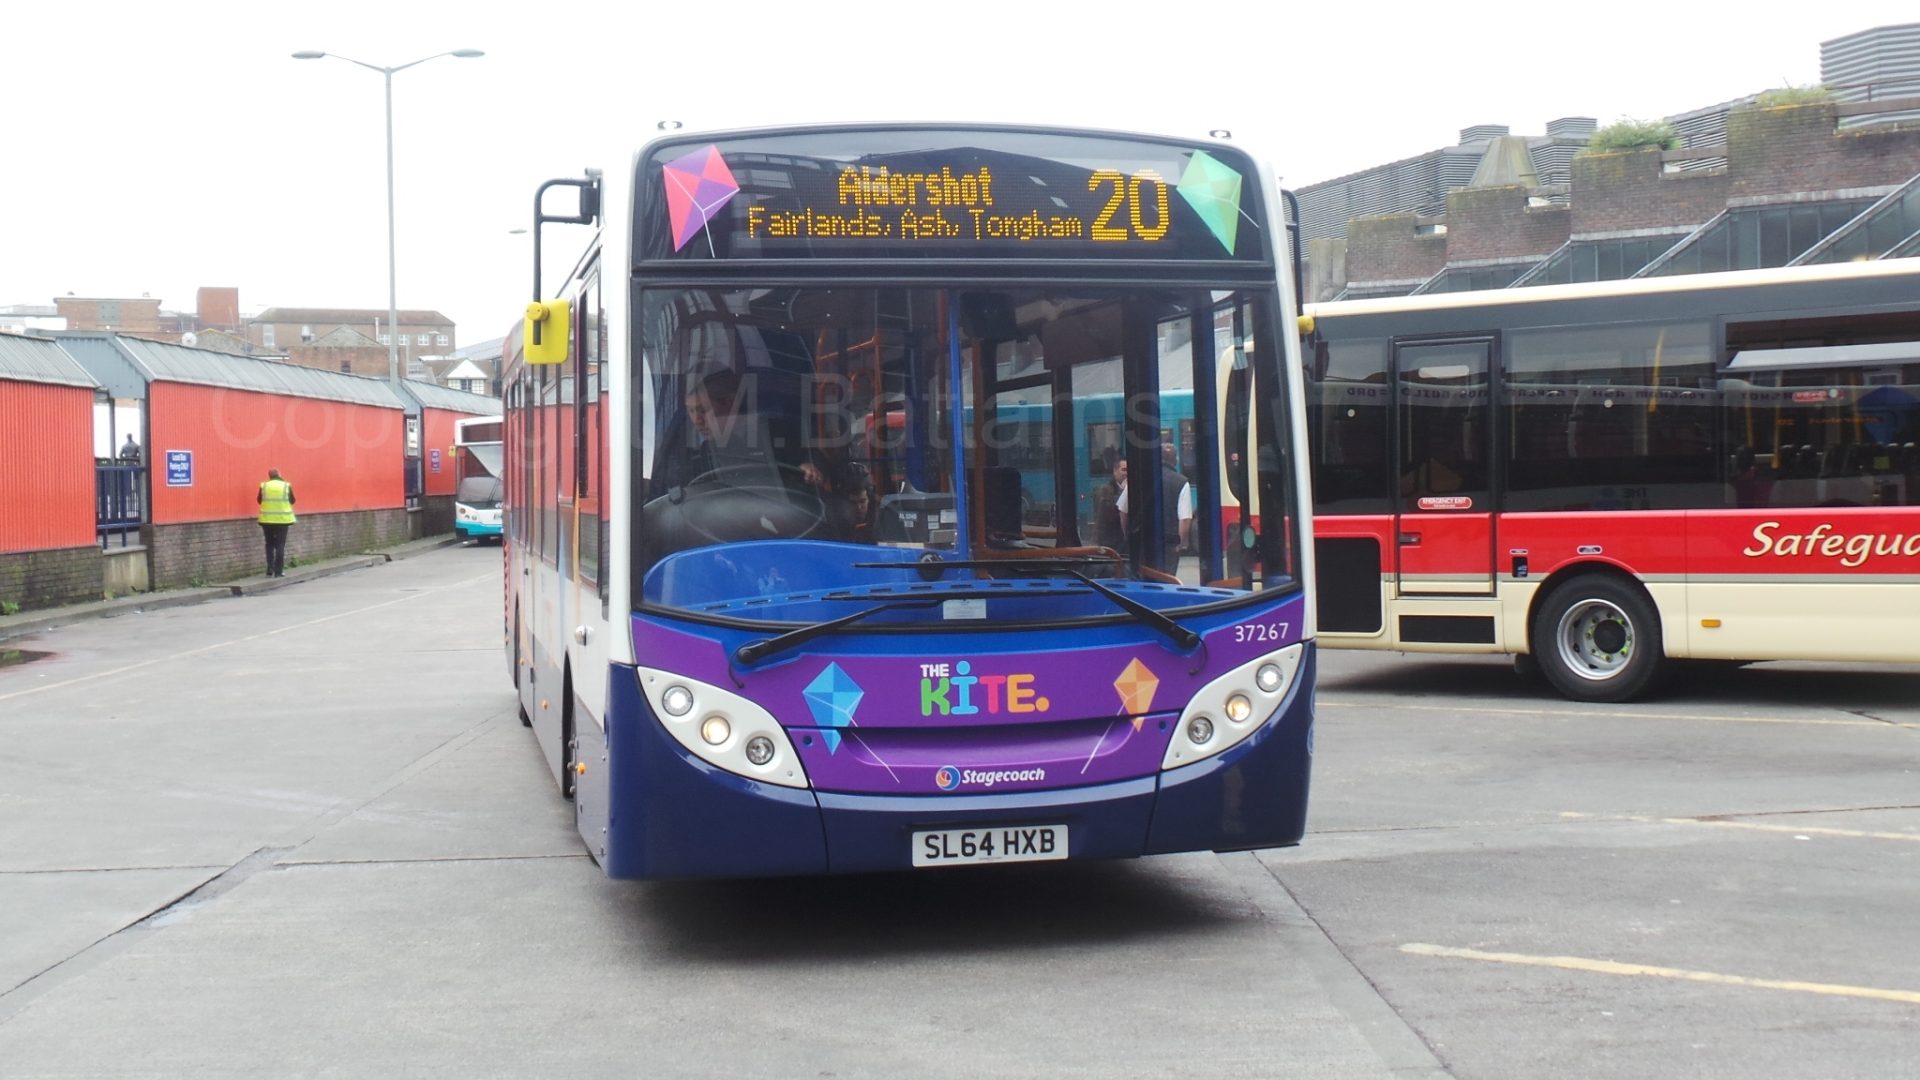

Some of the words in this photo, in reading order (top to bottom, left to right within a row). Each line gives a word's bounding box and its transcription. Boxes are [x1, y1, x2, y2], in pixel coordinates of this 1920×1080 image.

[838, 166, 994, 206] Aldershot
[1088, 169, 1169, 242] 20
[748, 208, 890, 240] Fairlands,
[900, 208, 960, 240] Ash,
[969, 208, 1083, 241] Tongham
[1234, 622, 1289, 642] 37267
[920, 663, 950, 678] THE
[961, 767, 1045, 787] Stagecoach
[924, 831, 995, 860] SL64
[1003, 828, 1056, 856] HXB
